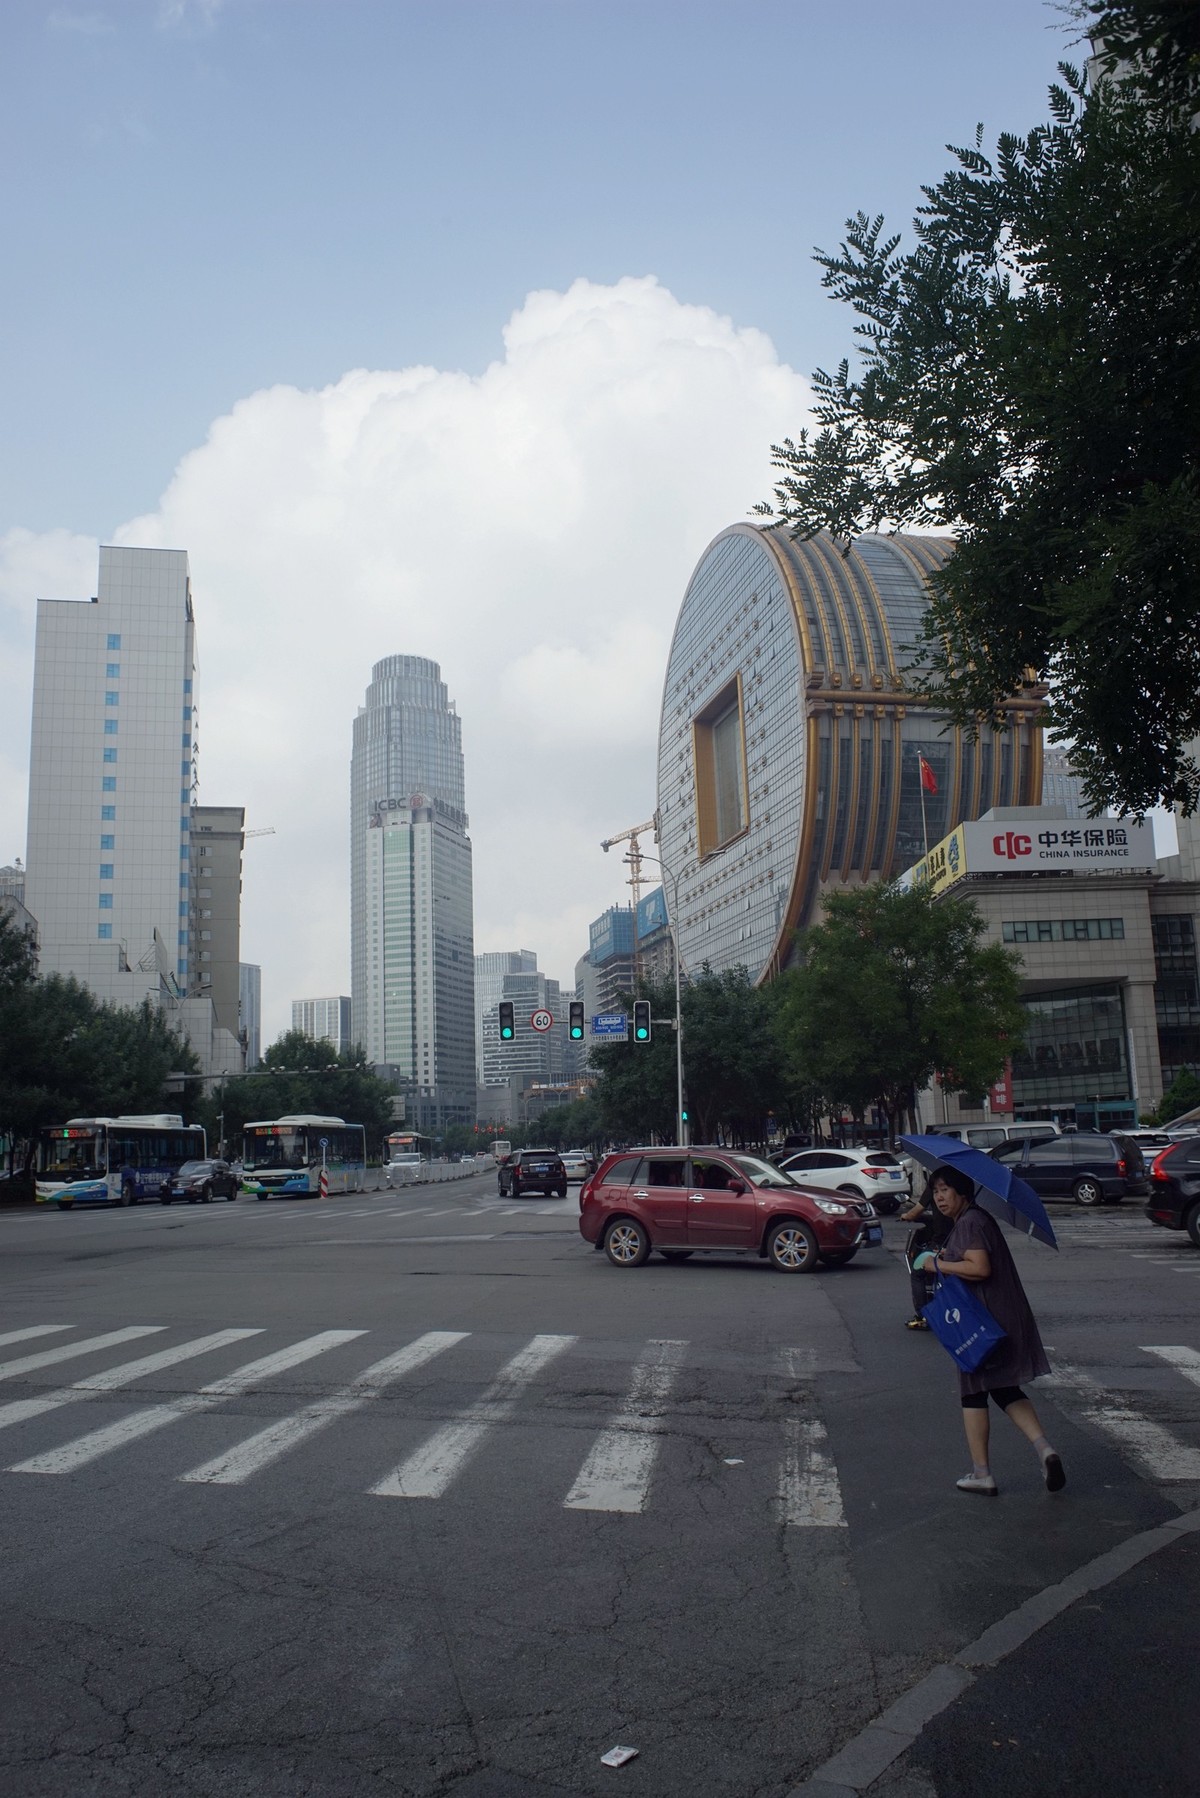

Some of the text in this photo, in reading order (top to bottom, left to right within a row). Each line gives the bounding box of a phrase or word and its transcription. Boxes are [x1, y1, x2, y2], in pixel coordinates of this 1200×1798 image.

[375, 797, 407, 812] ICBC
[1038, 829, 1128, 848] 中华保险
[1039, 849, 1129, 859] CHINA INSURANCE
[536, 1015, 549, 1026] 60
